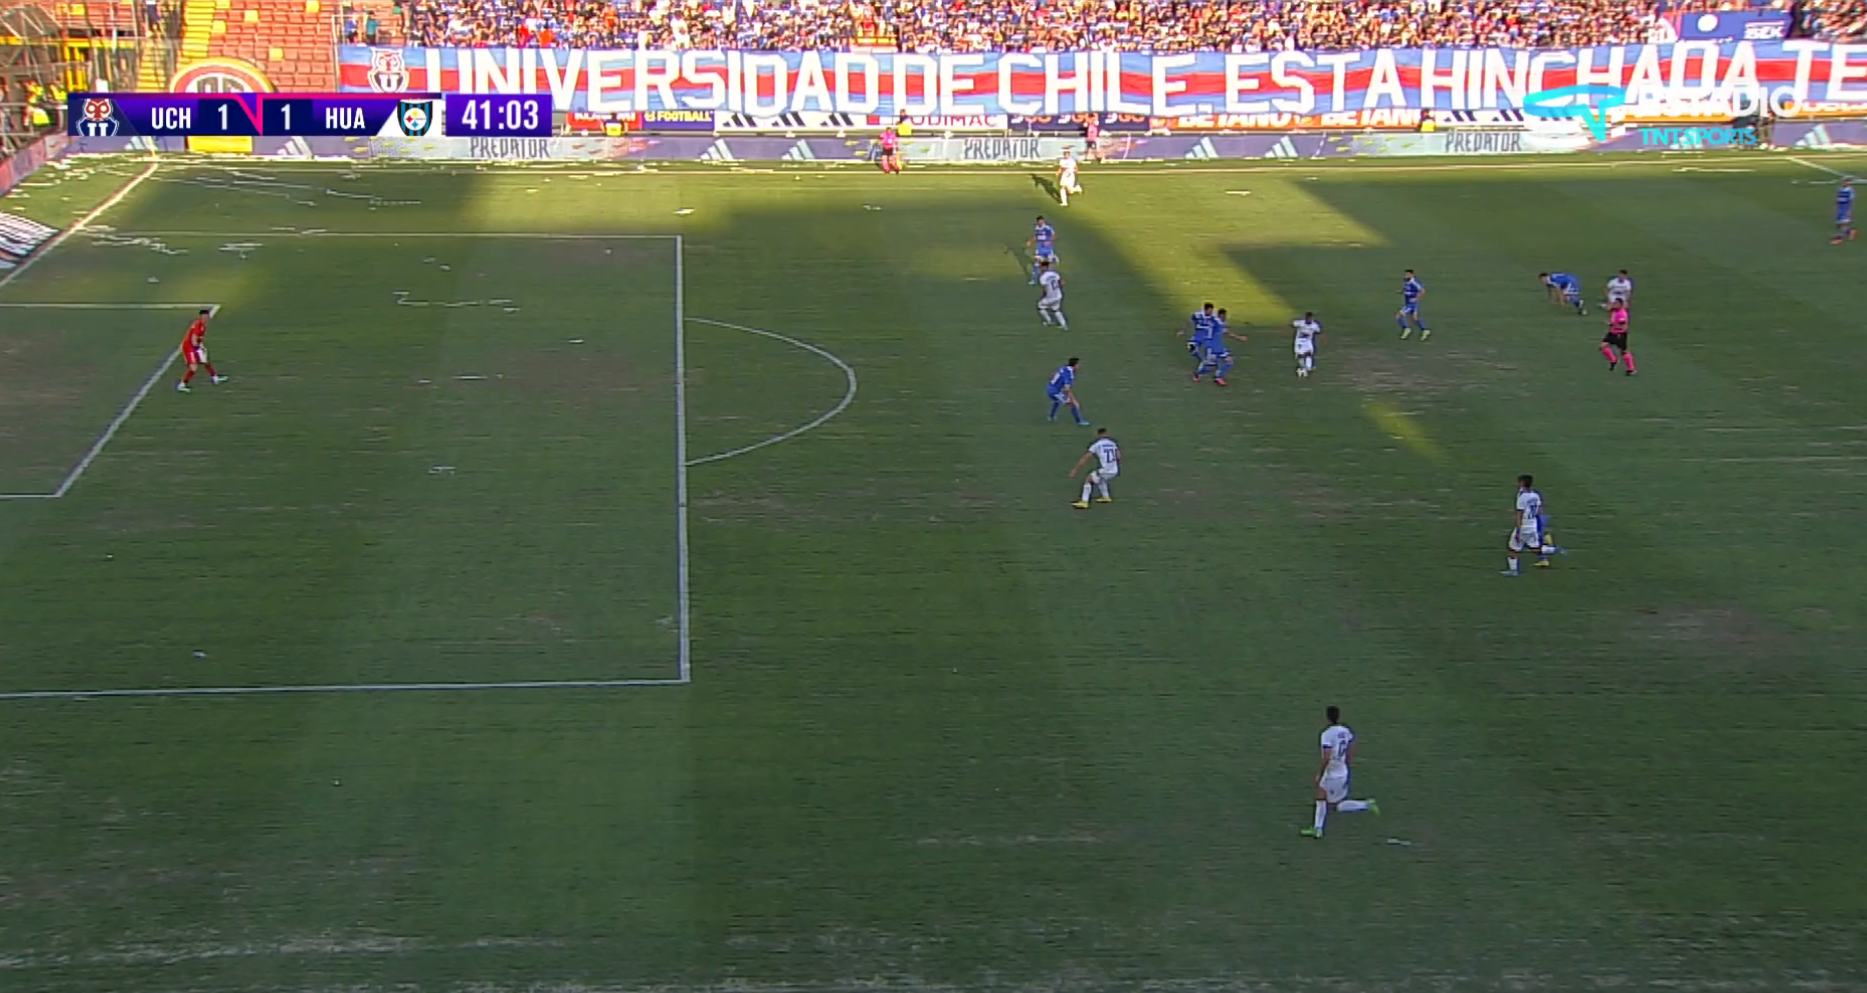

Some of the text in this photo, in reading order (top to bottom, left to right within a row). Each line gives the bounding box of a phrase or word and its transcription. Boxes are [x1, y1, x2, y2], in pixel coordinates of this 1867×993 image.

[426, 48, 879, 117] UNIVERSIDAD
[894, 53, 986, 115] DE
[1420, 40, 1761, 108] HINCHADA
[470, 136, 550, 158] PREDATOR
[963, 137, 1041, 160] PREDATOR
[1445, 132, 1523, 153] PREDATOR
